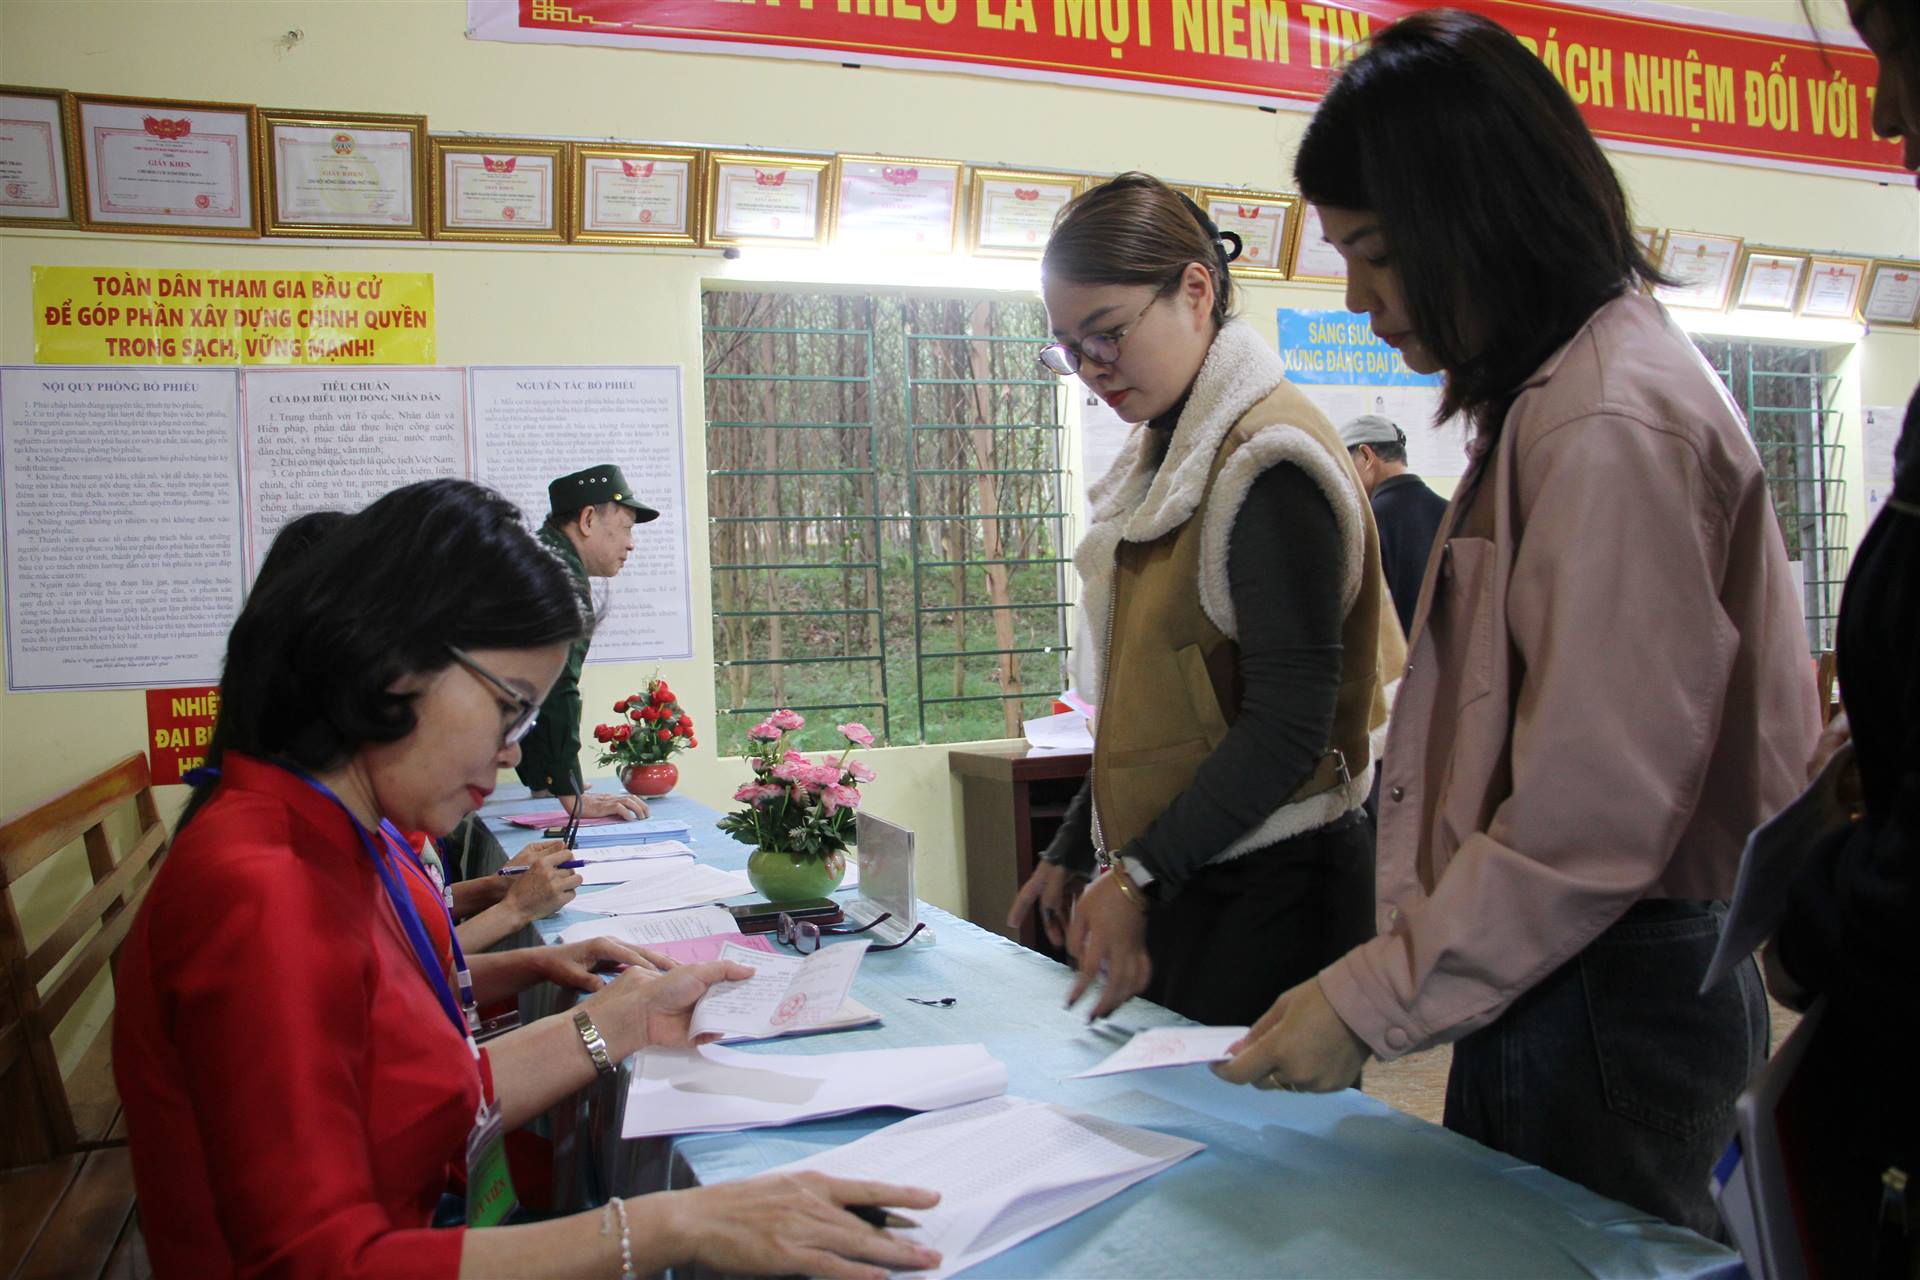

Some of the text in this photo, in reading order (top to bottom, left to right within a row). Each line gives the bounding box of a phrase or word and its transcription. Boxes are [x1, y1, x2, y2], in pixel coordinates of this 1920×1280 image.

[1624, 49, 1735, 133] NHIỆM
[1744, 54, 1799, 132] ĐỐI
[1807, 69, 1858, 139] VỚI
[93, 272, 383, 300] TOÀN DÂN THAM GIA BẦU CỬ
[45, 298, 427, 332] ĐỂ GÓP PHẦN XÂY DỰNG CHÍNH QUYỀN
[1308, 318, 1347, 345] SÁNG
[105, 334, 375, 362] TRONG SẠCH, VỮNG MẠNH!
[1283, 343, 1323, 372] XỨNG
[1327, 346, 1363, 373] ĐÁNG
[1366, 351, 1389, 379] ĐẠI
[42, 383, 64, 392] NỘI
[68, 383, 92, 392] QUY
[98, 383, 140, 392] PHÒNG
[293, 394, 311, 403] ĐẠI
[339, 394, 358, 403] HỘI
[392, 394, 418, 402] NHÂN
[421, 393, 441, 401] DÂN
[321, 381, 346, 391] TIÊU
[172, 691, 221, 720] NHIỆ
[155, 727, 190, 752] ĐẠI
